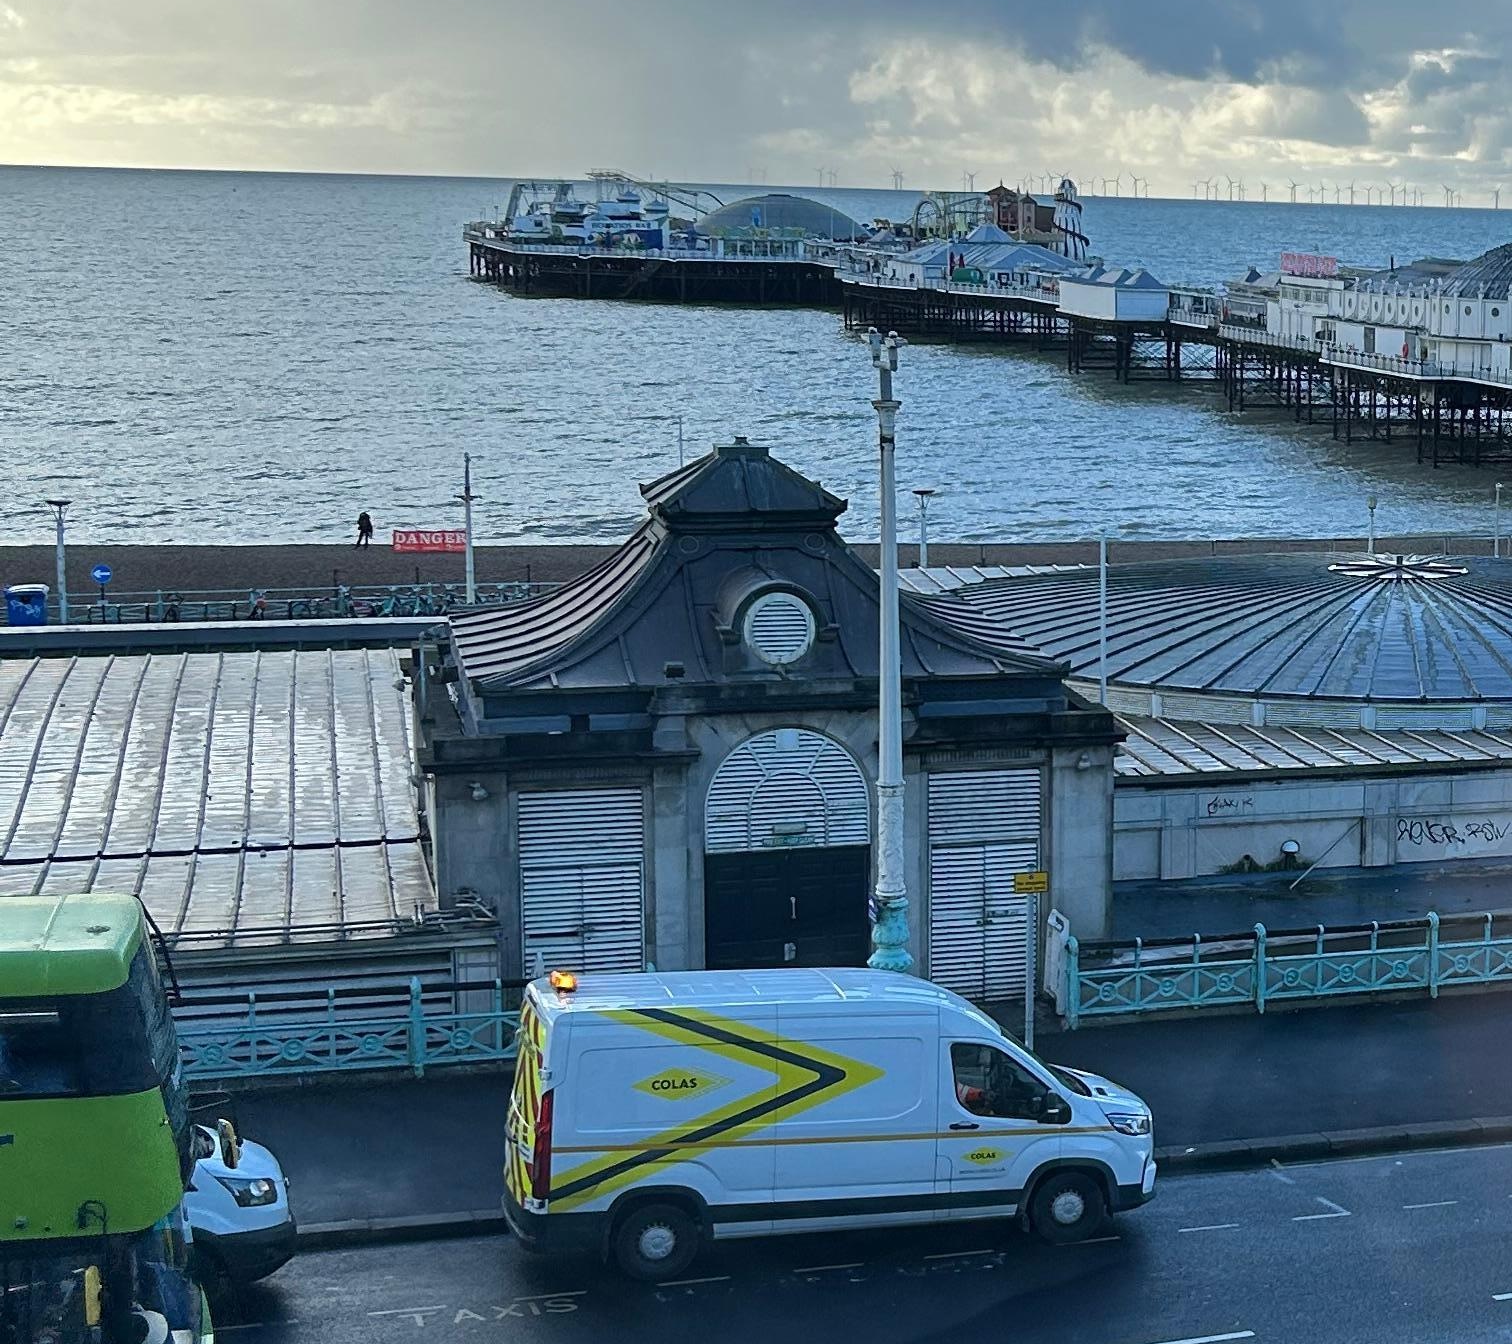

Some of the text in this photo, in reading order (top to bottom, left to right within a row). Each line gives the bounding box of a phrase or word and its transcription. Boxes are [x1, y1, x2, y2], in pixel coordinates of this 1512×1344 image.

[394, 532, 467, 544] DANGER
[651, 1078, 698, 1090] COLAS
[970, 1152, 996, 1160] COLAS
[397, 1298, 578, 1327] TAXIS
